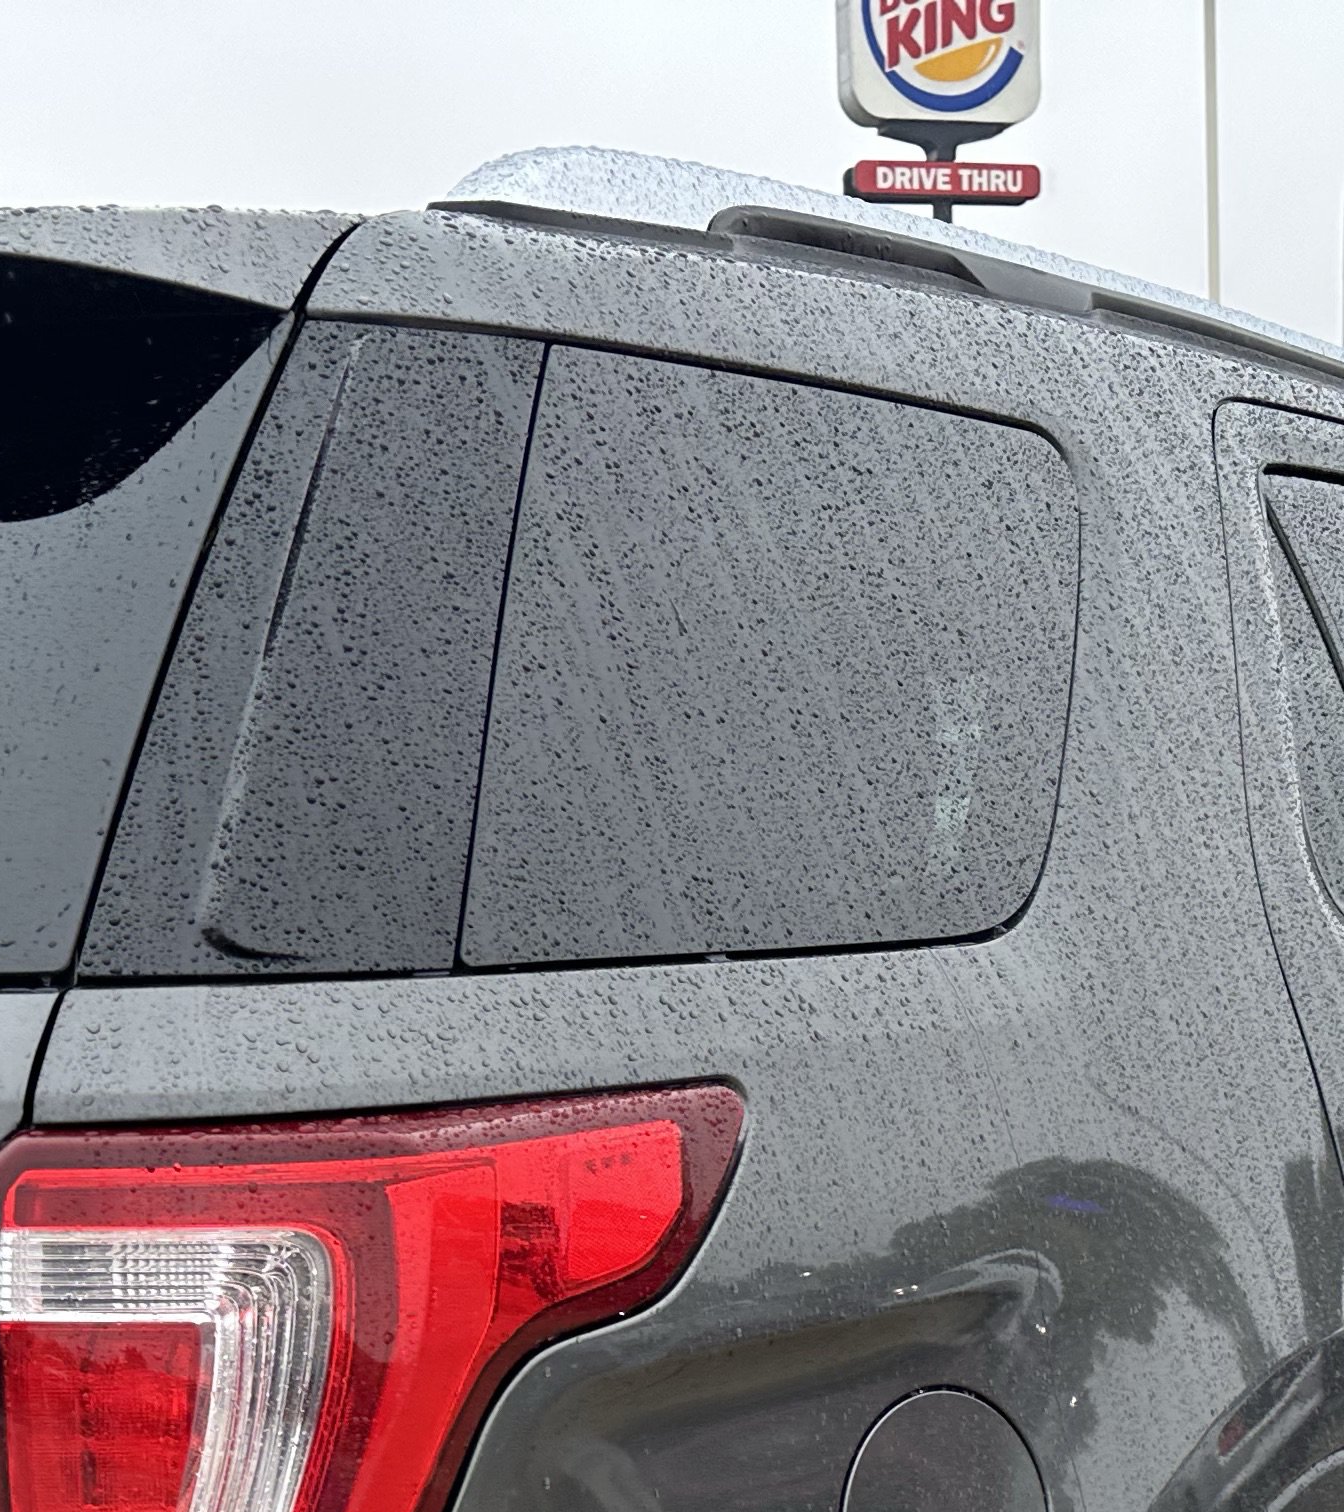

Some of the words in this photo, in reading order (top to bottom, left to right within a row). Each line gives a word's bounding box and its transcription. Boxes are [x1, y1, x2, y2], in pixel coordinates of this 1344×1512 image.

[886, 0, 1016, 69] KING
[875, 166, 952, 190] DRIVE
[958, 168, 1023, 192] THRU
